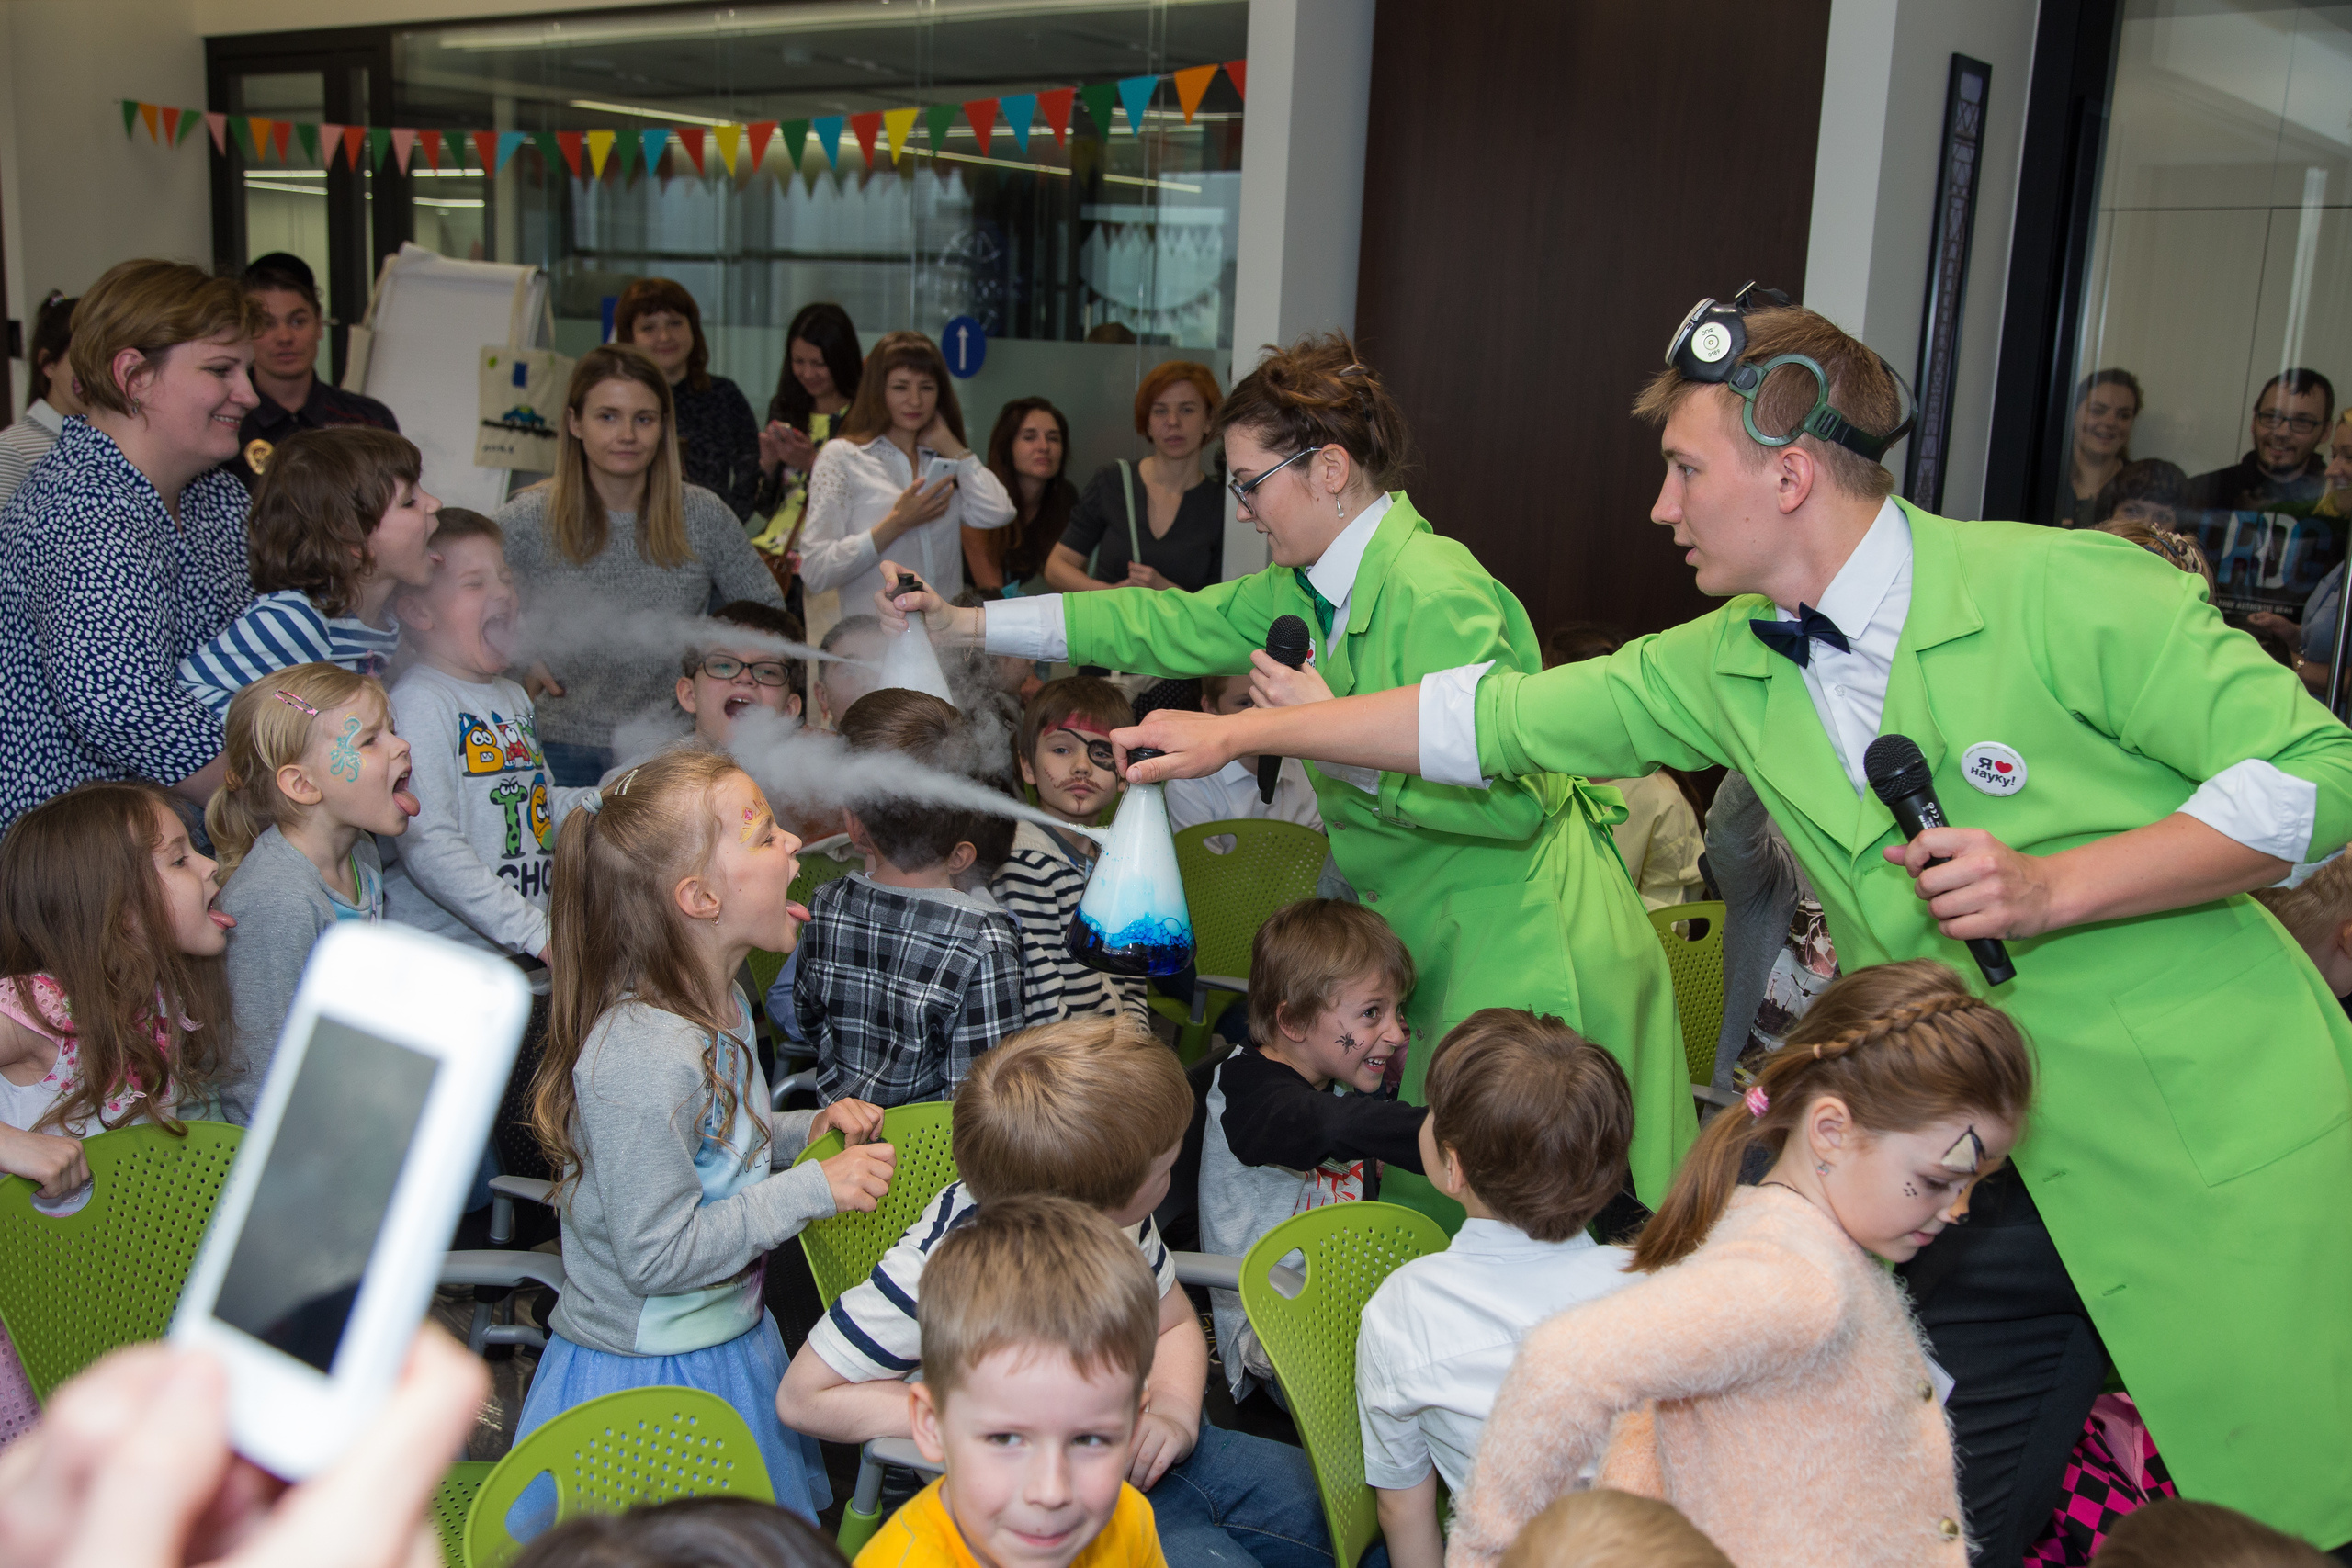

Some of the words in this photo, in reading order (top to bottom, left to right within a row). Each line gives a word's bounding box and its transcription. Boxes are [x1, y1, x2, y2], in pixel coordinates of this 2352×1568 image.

[1978, 757, 1993, 770] Я
[1970, 766, 2016, 787] науку!
[489, 773, 553, 856] TO
